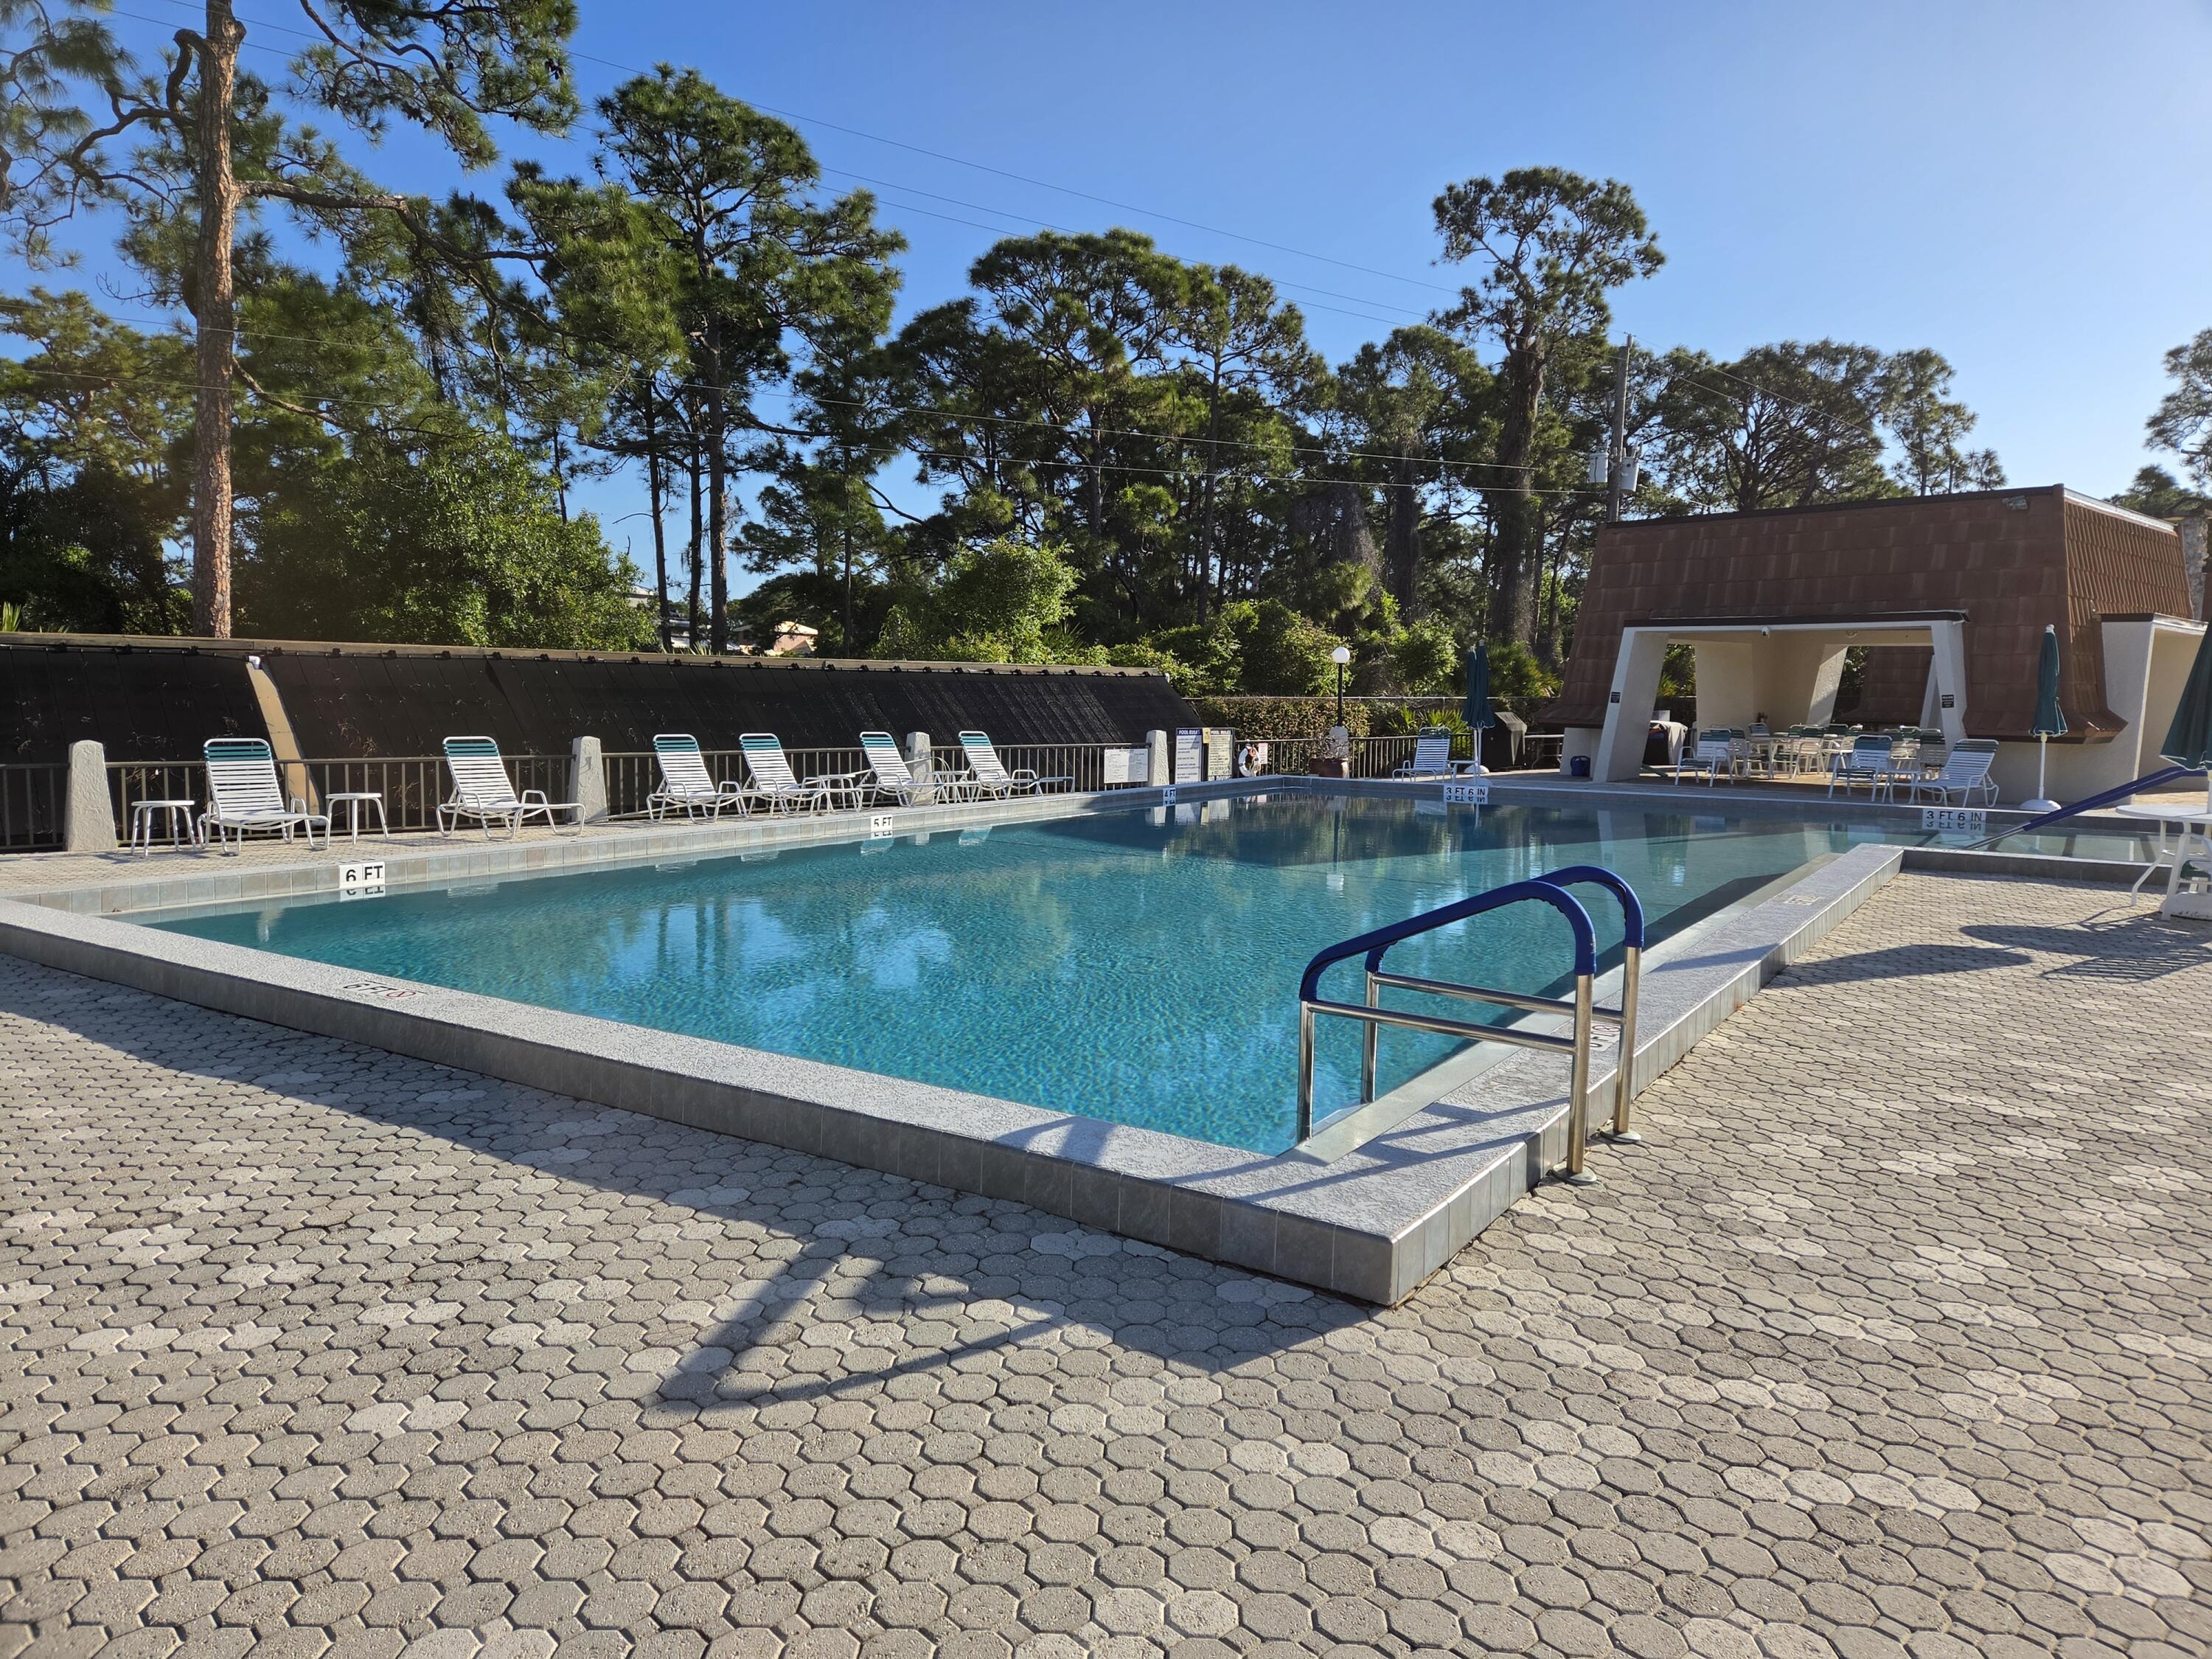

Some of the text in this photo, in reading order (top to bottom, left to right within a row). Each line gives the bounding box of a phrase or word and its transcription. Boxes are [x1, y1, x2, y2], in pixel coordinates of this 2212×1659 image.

[1169, 790, 1175, 798] FT
[1455, 787, 1465, 795] FT
[1927, 811, 1934, 819] 3
[1958, 812, 1966, 821] 6
[1970, 812, 1982, 821] IN
[874, 816, 892, 827] 5 FT
[346, 866, 383, 882] 6 FT
